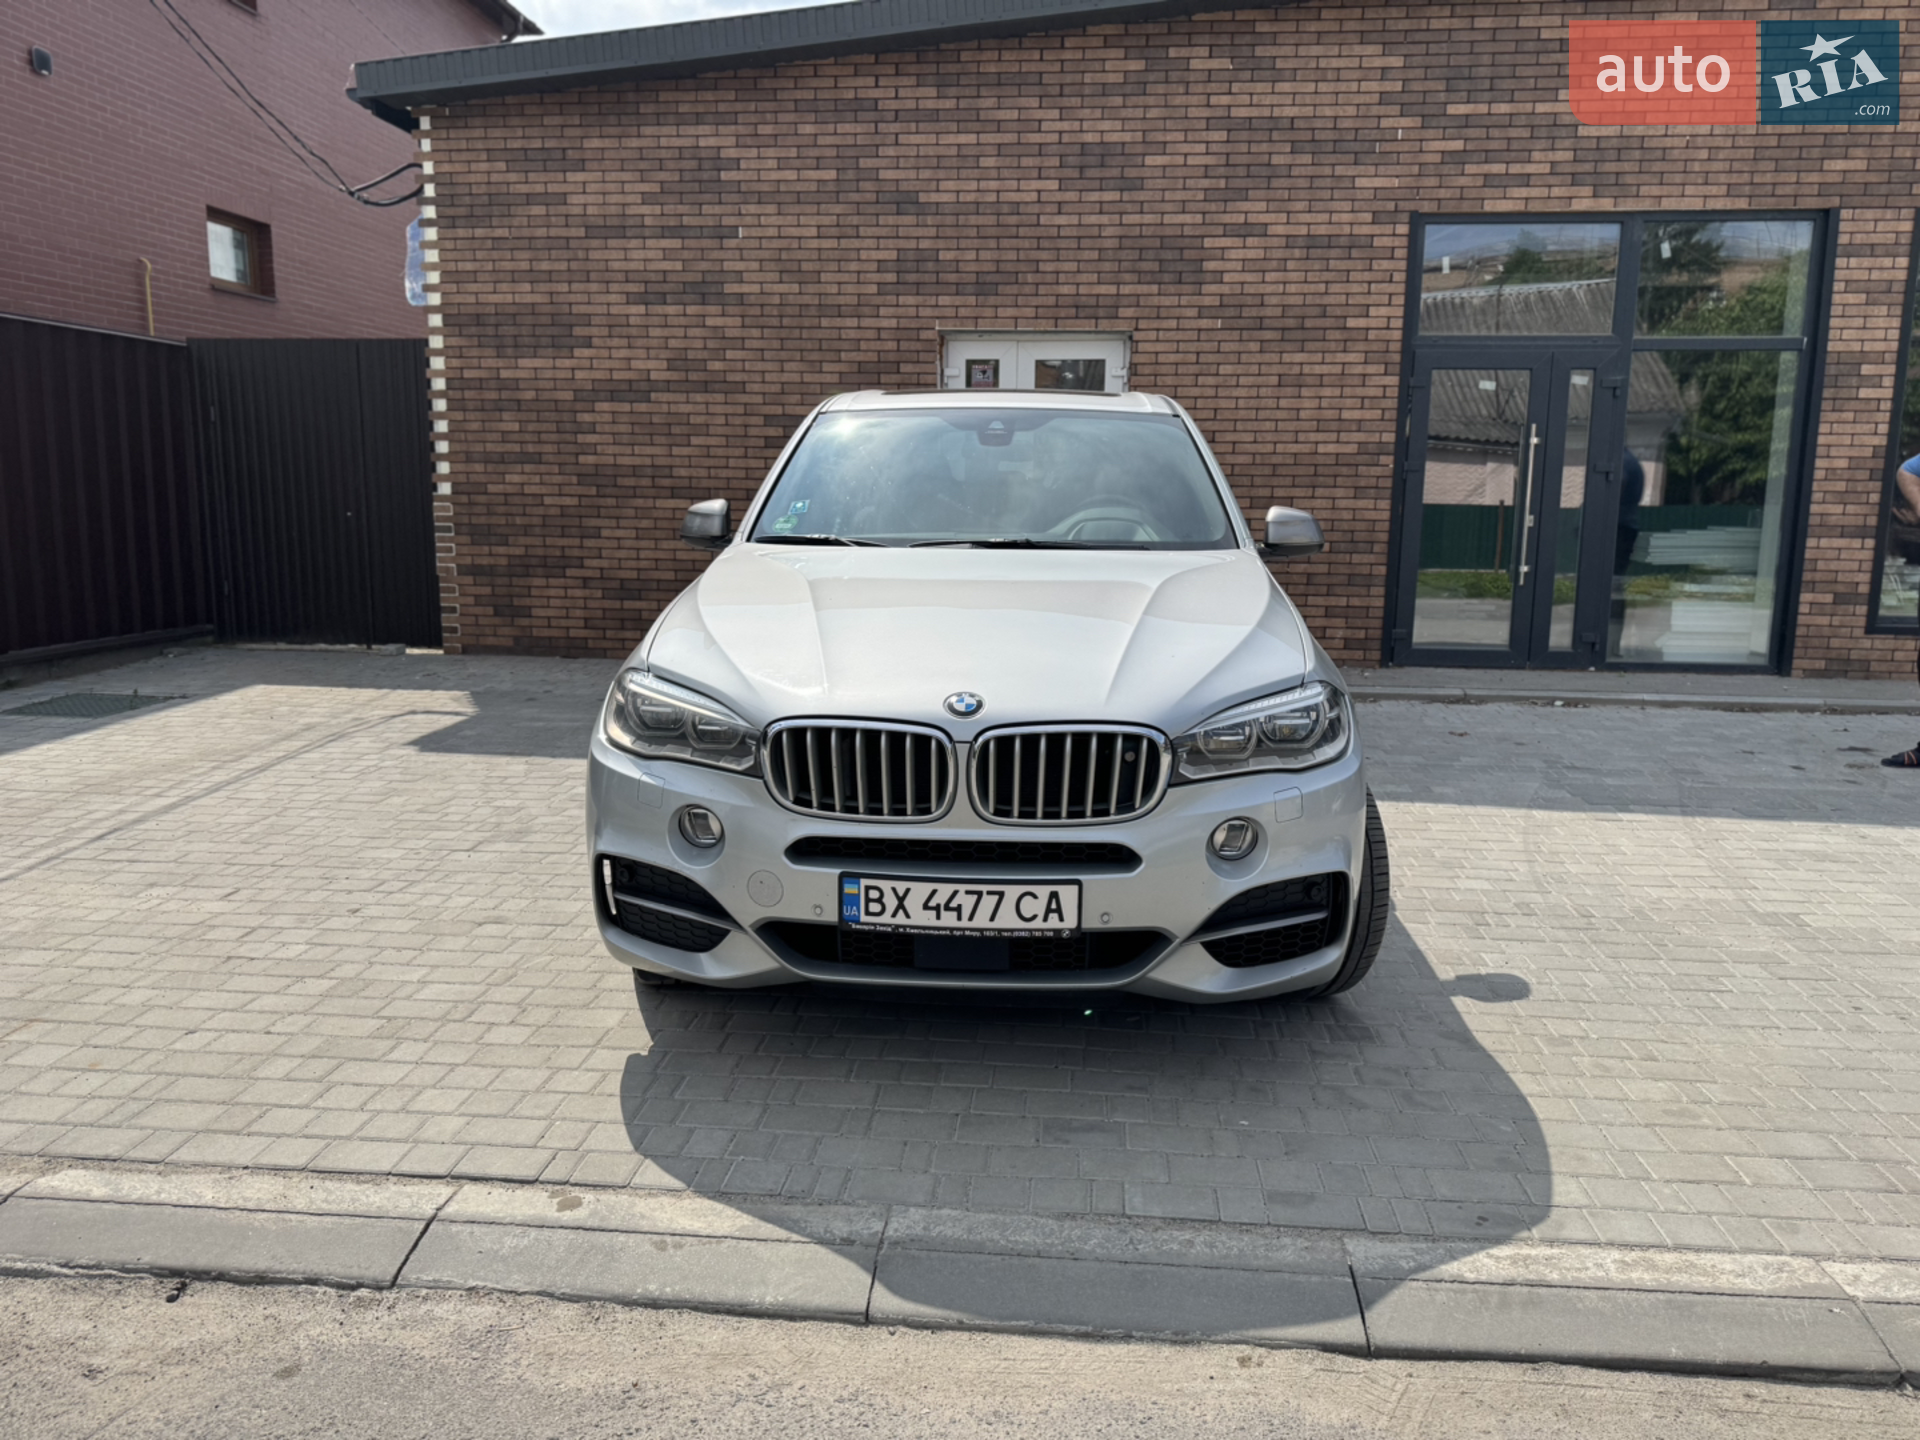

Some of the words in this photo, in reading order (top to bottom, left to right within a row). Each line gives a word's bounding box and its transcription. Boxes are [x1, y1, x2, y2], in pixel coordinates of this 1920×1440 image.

[843, 905, 859, 917] UA
[864, 884, 912, 919] BX
[922, 888, 1005, 922] 4477
[1015, 890, 1065, 923] CA
